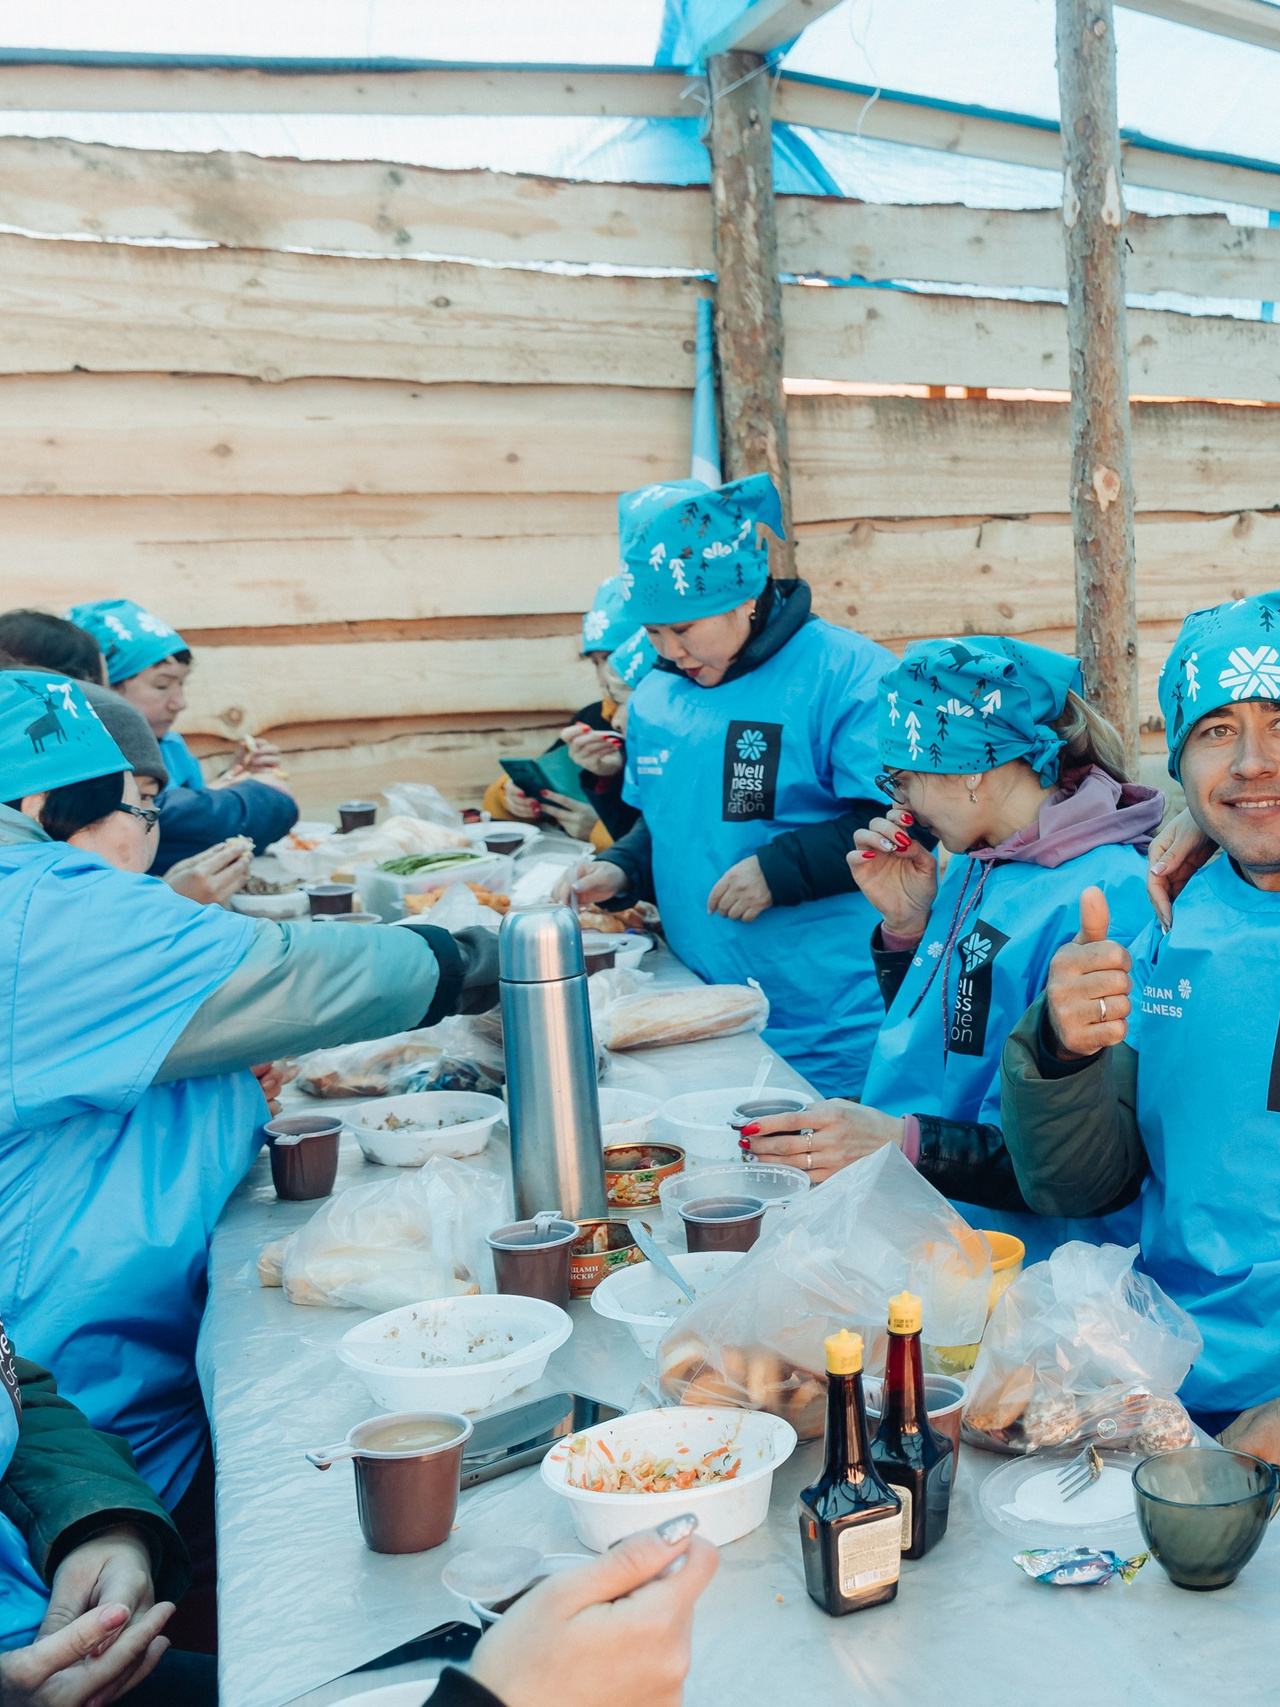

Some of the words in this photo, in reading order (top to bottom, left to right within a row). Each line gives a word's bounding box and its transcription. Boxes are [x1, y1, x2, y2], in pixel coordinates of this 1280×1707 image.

[733, 762, 765, 780] Well
[731, 777, 763, 792] ness
[729, 788, 765, 802] Gene
[1142, 985, 1173, 1000] ERIAN
[1141, 1001, 1183, 1018] LLNESS
[950, 1026, 973, 1043] on
[570, 1265, 599, 1274] ЩАМИ
[570, 1272, 594, 1281] НСКИ
